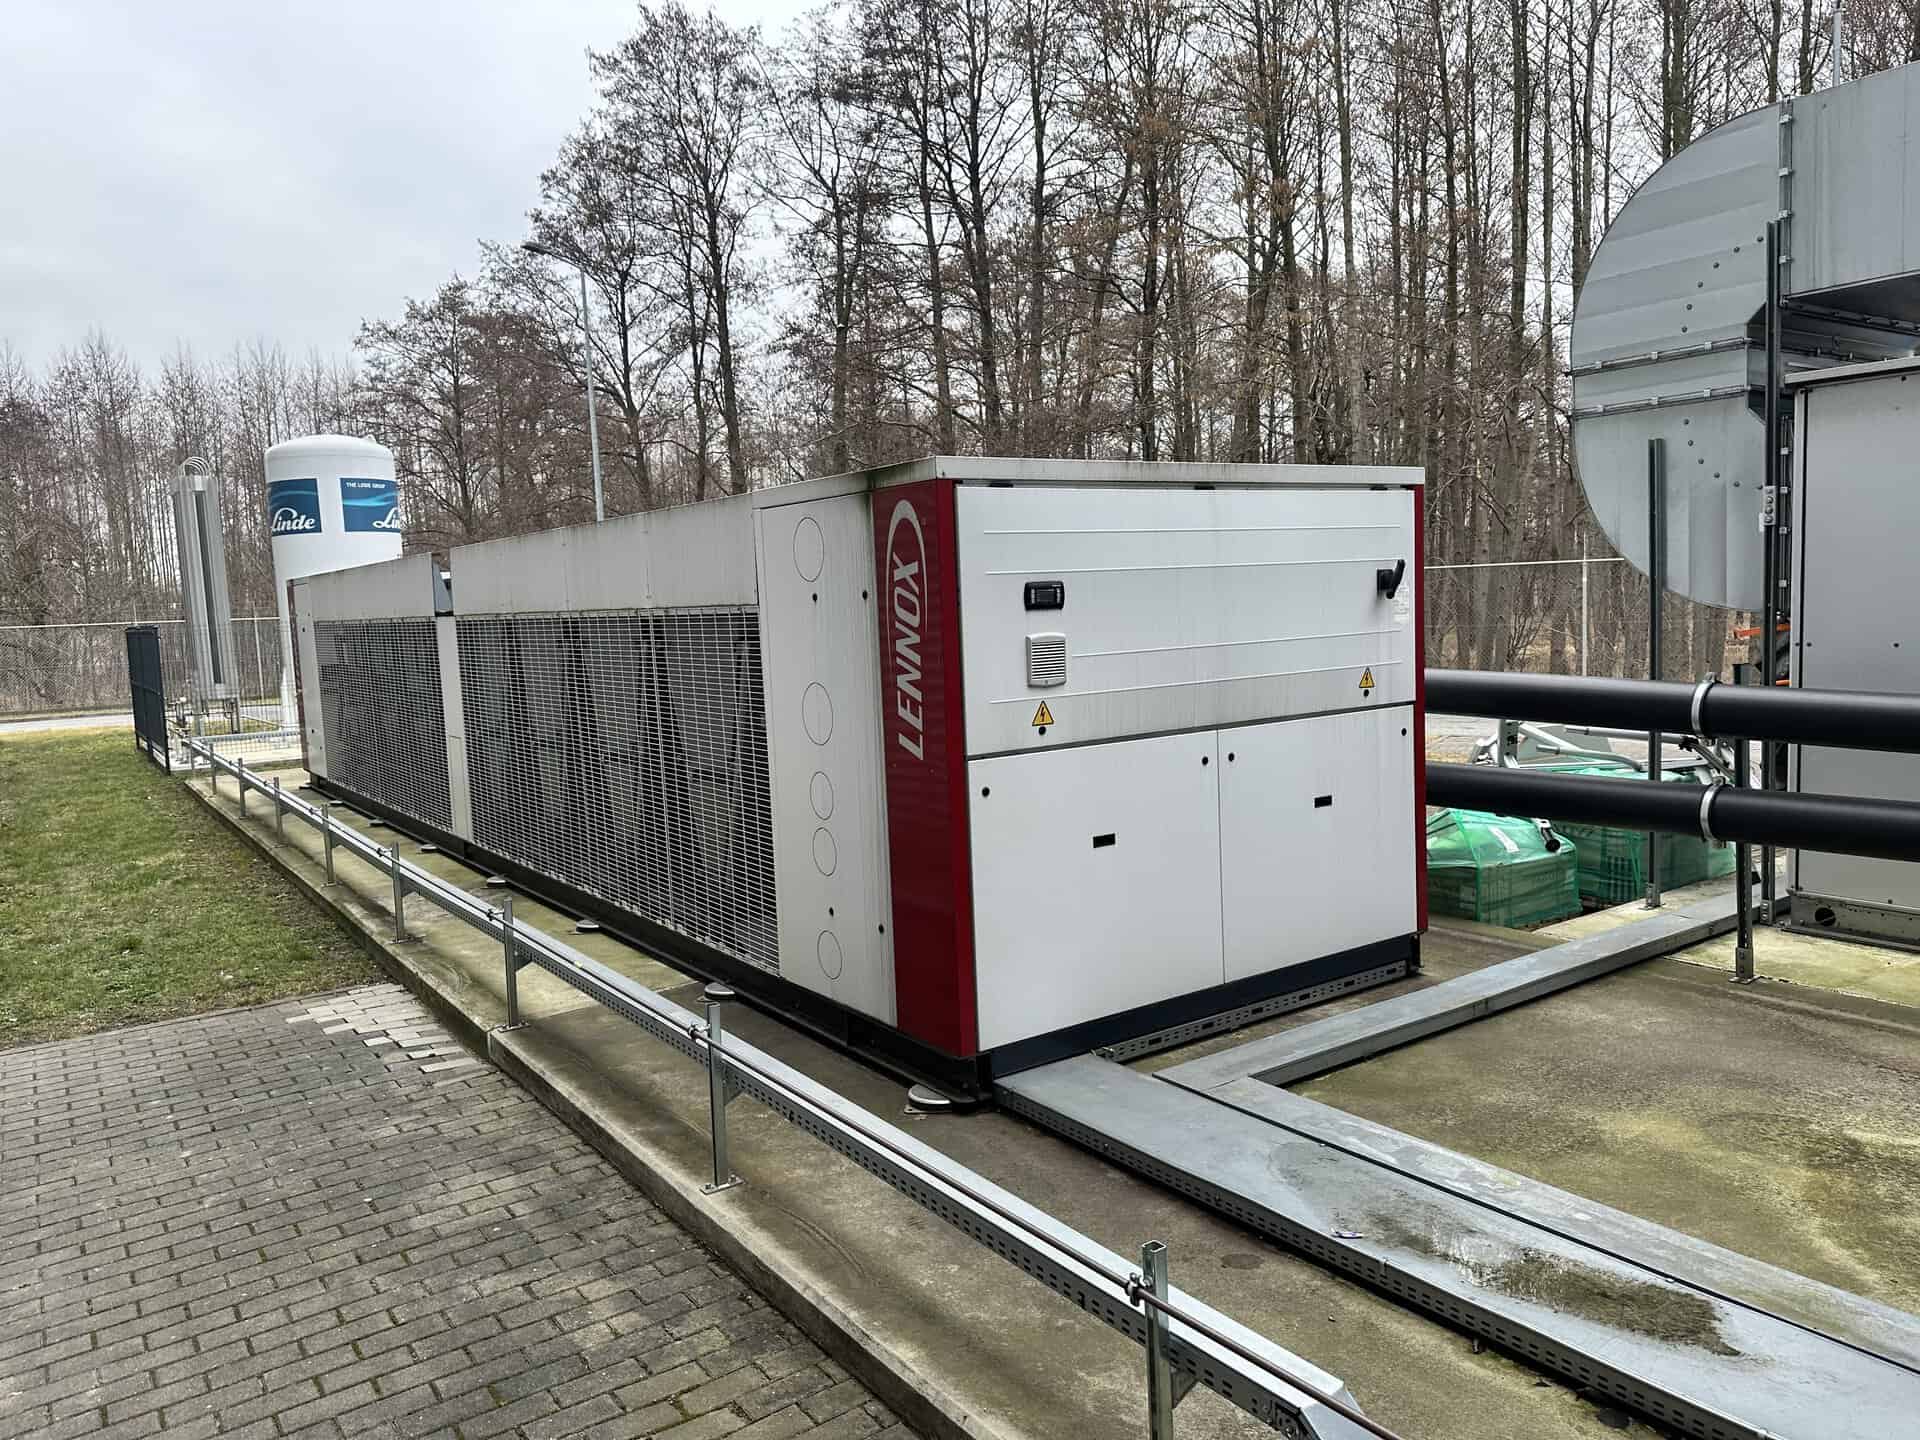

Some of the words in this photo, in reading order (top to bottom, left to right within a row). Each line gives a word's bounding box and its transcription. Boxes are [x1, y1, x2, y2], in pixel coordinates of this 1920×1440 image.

[271, 507, 316, 531] Linde
[372, 507, 400, 529] Lin
[893, 552, 924, 760] LENNOX
